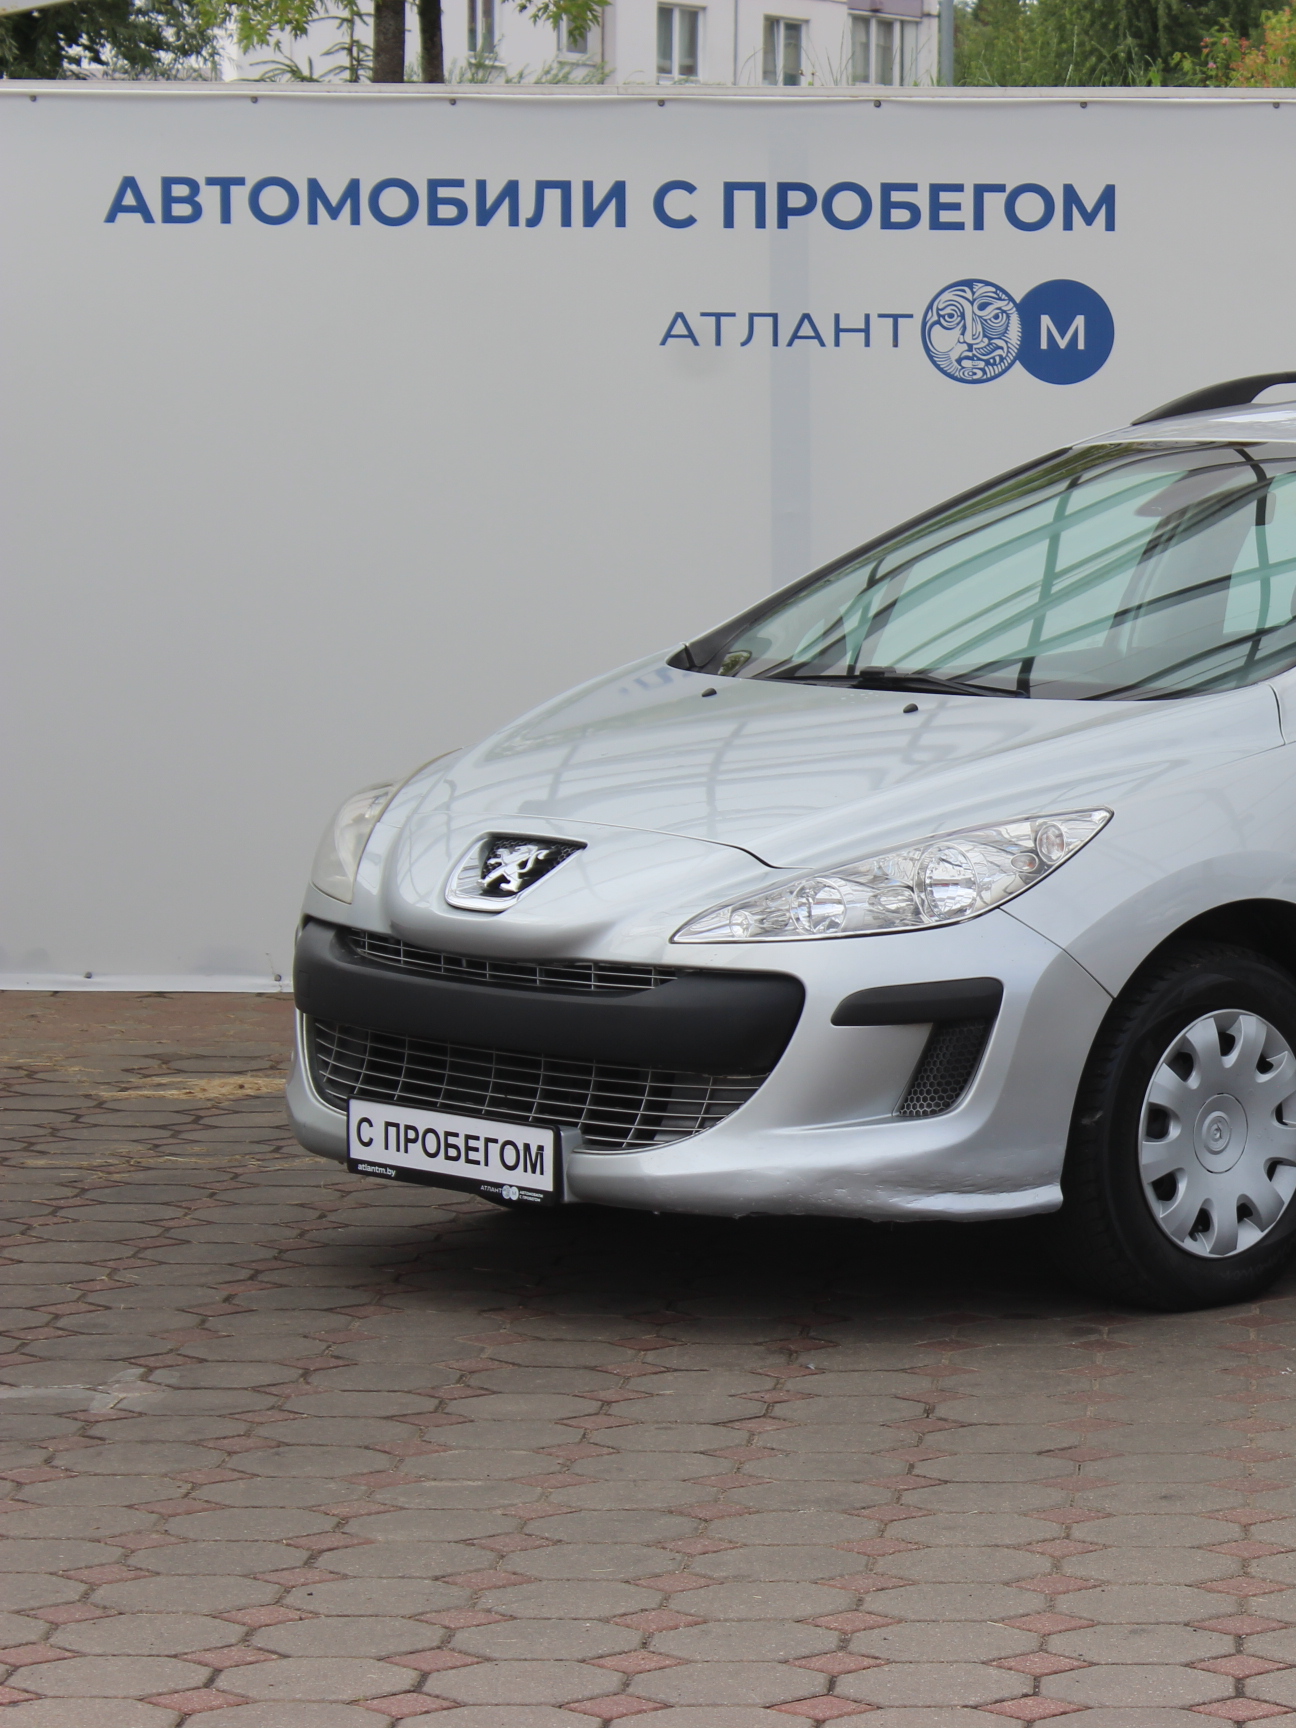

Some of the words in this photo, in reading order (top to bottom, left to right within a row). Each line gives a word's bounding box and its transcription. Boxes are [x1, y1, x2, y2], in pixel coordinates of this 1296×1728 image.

[104, 175, 627, 229] АВТОМОБИЛИ
[653, 180, 698, 230] С
[723, 181, 1116, 233] ПРОБЕГОМ
[659, 312, 915, 348] АТЛАНТ
[356, 1116, 374, 1148] С
[384, 1120, 545, 1176] ПРОБЕГОМ
[357, 1163, 396, 1177] atlantm.by
